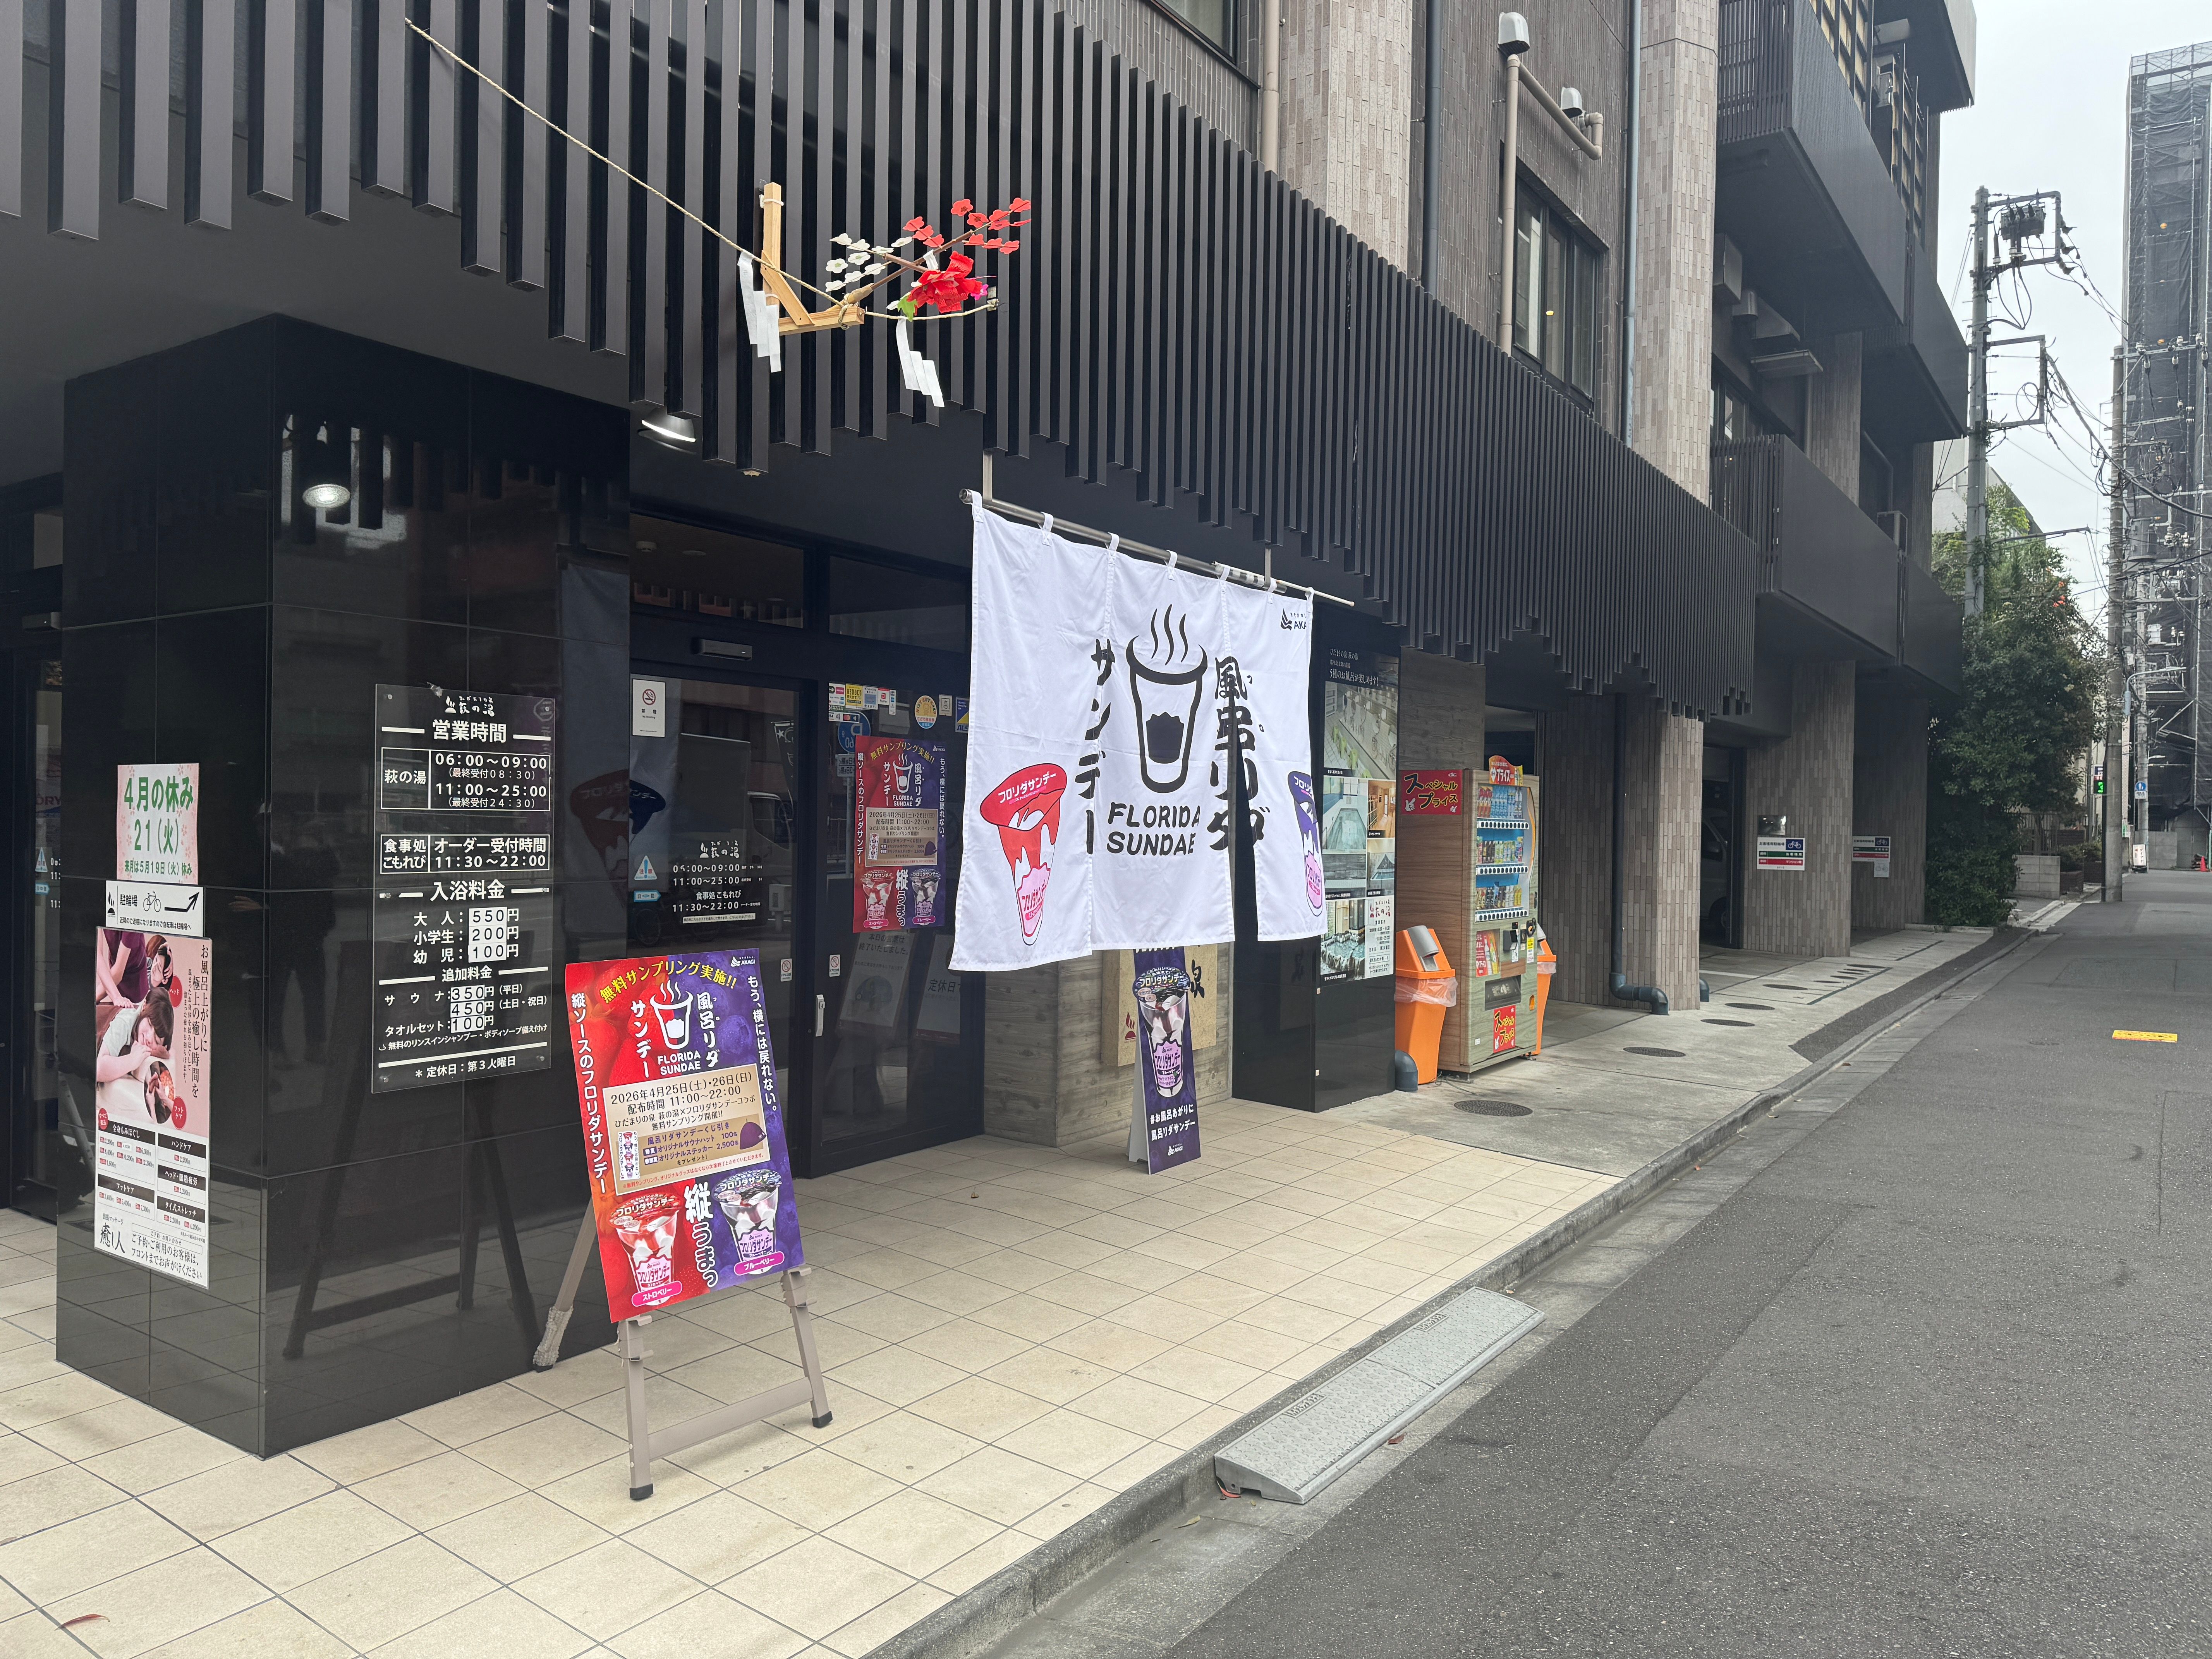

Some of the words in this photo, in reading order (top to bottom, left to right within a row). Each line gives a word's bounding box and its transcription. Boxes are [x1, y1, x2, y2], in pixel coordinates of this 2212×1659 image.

[459, 702, 495, 716] 萩の湯
[433, 720, 506, 743] 営業時間
[870, 741, 935, 764] 無料サンプリング実施!!
[1075, 638, 1116, 855] サンデー
[435, 754, 546, 769] 06:00〜09:00
[385, 769, 426, 785] 萩の湯
[449, 768, 535, 780] (最終受付08:30)
[436, 783, 546, 797] 11:00〜25:00
[998, 771, 1057, 804] フロリダサンデー
[1404, 773, 1458, 794] スペシャル
[124, 776, 194, 812] 4月の休み
[449, 797, 535, 808] (最終受付24:30)
[1015, 790, 1040, 802] ストロベリー
[1418, 791, 1458, 809] プライス
[1108, 802, 1201, 828] FLORIDA
[134, 817, 179, 854] 21(火)
[1106, 831, 1197, 856] SUNDAE
[384, 839, 426, 853] 食事処
[434, 838, 546, 853] オーダー受付時間
[711, 847, 739, 859] 萩の湯
[383, 857, 426, 869] こもれび
[435, 855, 546, 867] 11:30〜22:00
[430, 879, 505, 901] 入浴料金
[696, 891, 715, 900] 食事処
[716, 890, 742, 899] こもれび
[896, 869, 908, 927] 縦うまっ
[120, 894, 137, 907] 駐輪場
[120, 917, 191, 929] 近隣のご迷惑になりますので自転車は駐輪場へ
[472, 908, 519, 923] 550円
[472, 926, 519, 941] 200円
[869, 934, 905, 943] 本日の営業は
[473, 944, 519, 958] 100円
[442, 965, 492, 982] 追加料金
[599, 960, 737, 1004] 無料サンプリング実施!!
[1139, 973, 1184, 987] フロリダサンデー
[170, 988, 180, 996] ヘッド
[452, 986, 494, 1001] 350円
[499, 984, 522, 995] (平日)
[452, 1001, 494, 1015] 450円
[499, 995, 547, 1010] (土日・祝日)
[452, 1015, 494, 1032] 100円
[697, 992, 720, 1068] 風呂リダ
[1494, 1010, 1515, 1033] スペシャル
[192, 975, 200, 1097] 極上の癒し時間を
[388, 1024, 547, 1050] 無料のリンスインシャンプー・ボディソープ備え付け
[630, 1000, 651, 1079] サンデー
[747, 976, 777, 1111] もう、横には戻れない。
[1499, 1027, 1515, 1046] プライス
[658, 1051, 701, 1066] FLORIDA
[1154, 1049, 1180, 1069] フロリダサンデー
[660, 1062, 701, 1076] SUNDAE
[571, 993, 608, 1194] 縦ソースのフロリダサンデー
[611, 1072, 752, 1105] 2026年4月25日(土)・26日(日)
[615, 1114, 655, 1128] ひだまりの泉
[659, 1094, 756, 1120] 萩の湯×フロリダサンデーコラボ
[628, 1099, 665, 1115] 配布時間
[1150, 1104, 1194, 1125] #お風呂あがりに
[652, 1111, 723, 1131] 無料サンプリング開催!!
[1151, 1119, 1195, 1141] 風呂リダサンデー
[113, 1124, 140, 1138] 全身もみほぐし
[648, 1122, 729, 1145] 風呂リダサンデーくじ引き
[172, 1141, 191, 1151] ハンドケア
[658, 1135, 715, 1152] オリジナルサウナハット
[659, 1146, 713, 1161] オリジナルステッカー
[716, 1140, 738, 1150] 2,500名
[677, 1154, 708, 1165] をプレゼント!
[117, 1183, 134, 1194] フットケア
[720, 1173, 776, 1191] フロリダサンデー
[166, 1201, 196, 1217] タイ式ストレッチ
[616, 1198, 674, 1217] フロリダサンデー
[100, 1223, 125, 1253] 癒し人
[684, 1181, 719, 1288] 縦うまっ
[740, 1234, 772, 1253] フロリダサンデー
[132, 1234, 198, 1266] ご予約・ご利用のお客様は、
[132, 1248, 202, 1279] フロントまでお声がけください
[744, 1257, 775, 1271] ブルーベリー
[637, 1263, 670, 1283] フロリダサンデー
[642, 1288, 673, 1301] ストロベリー
